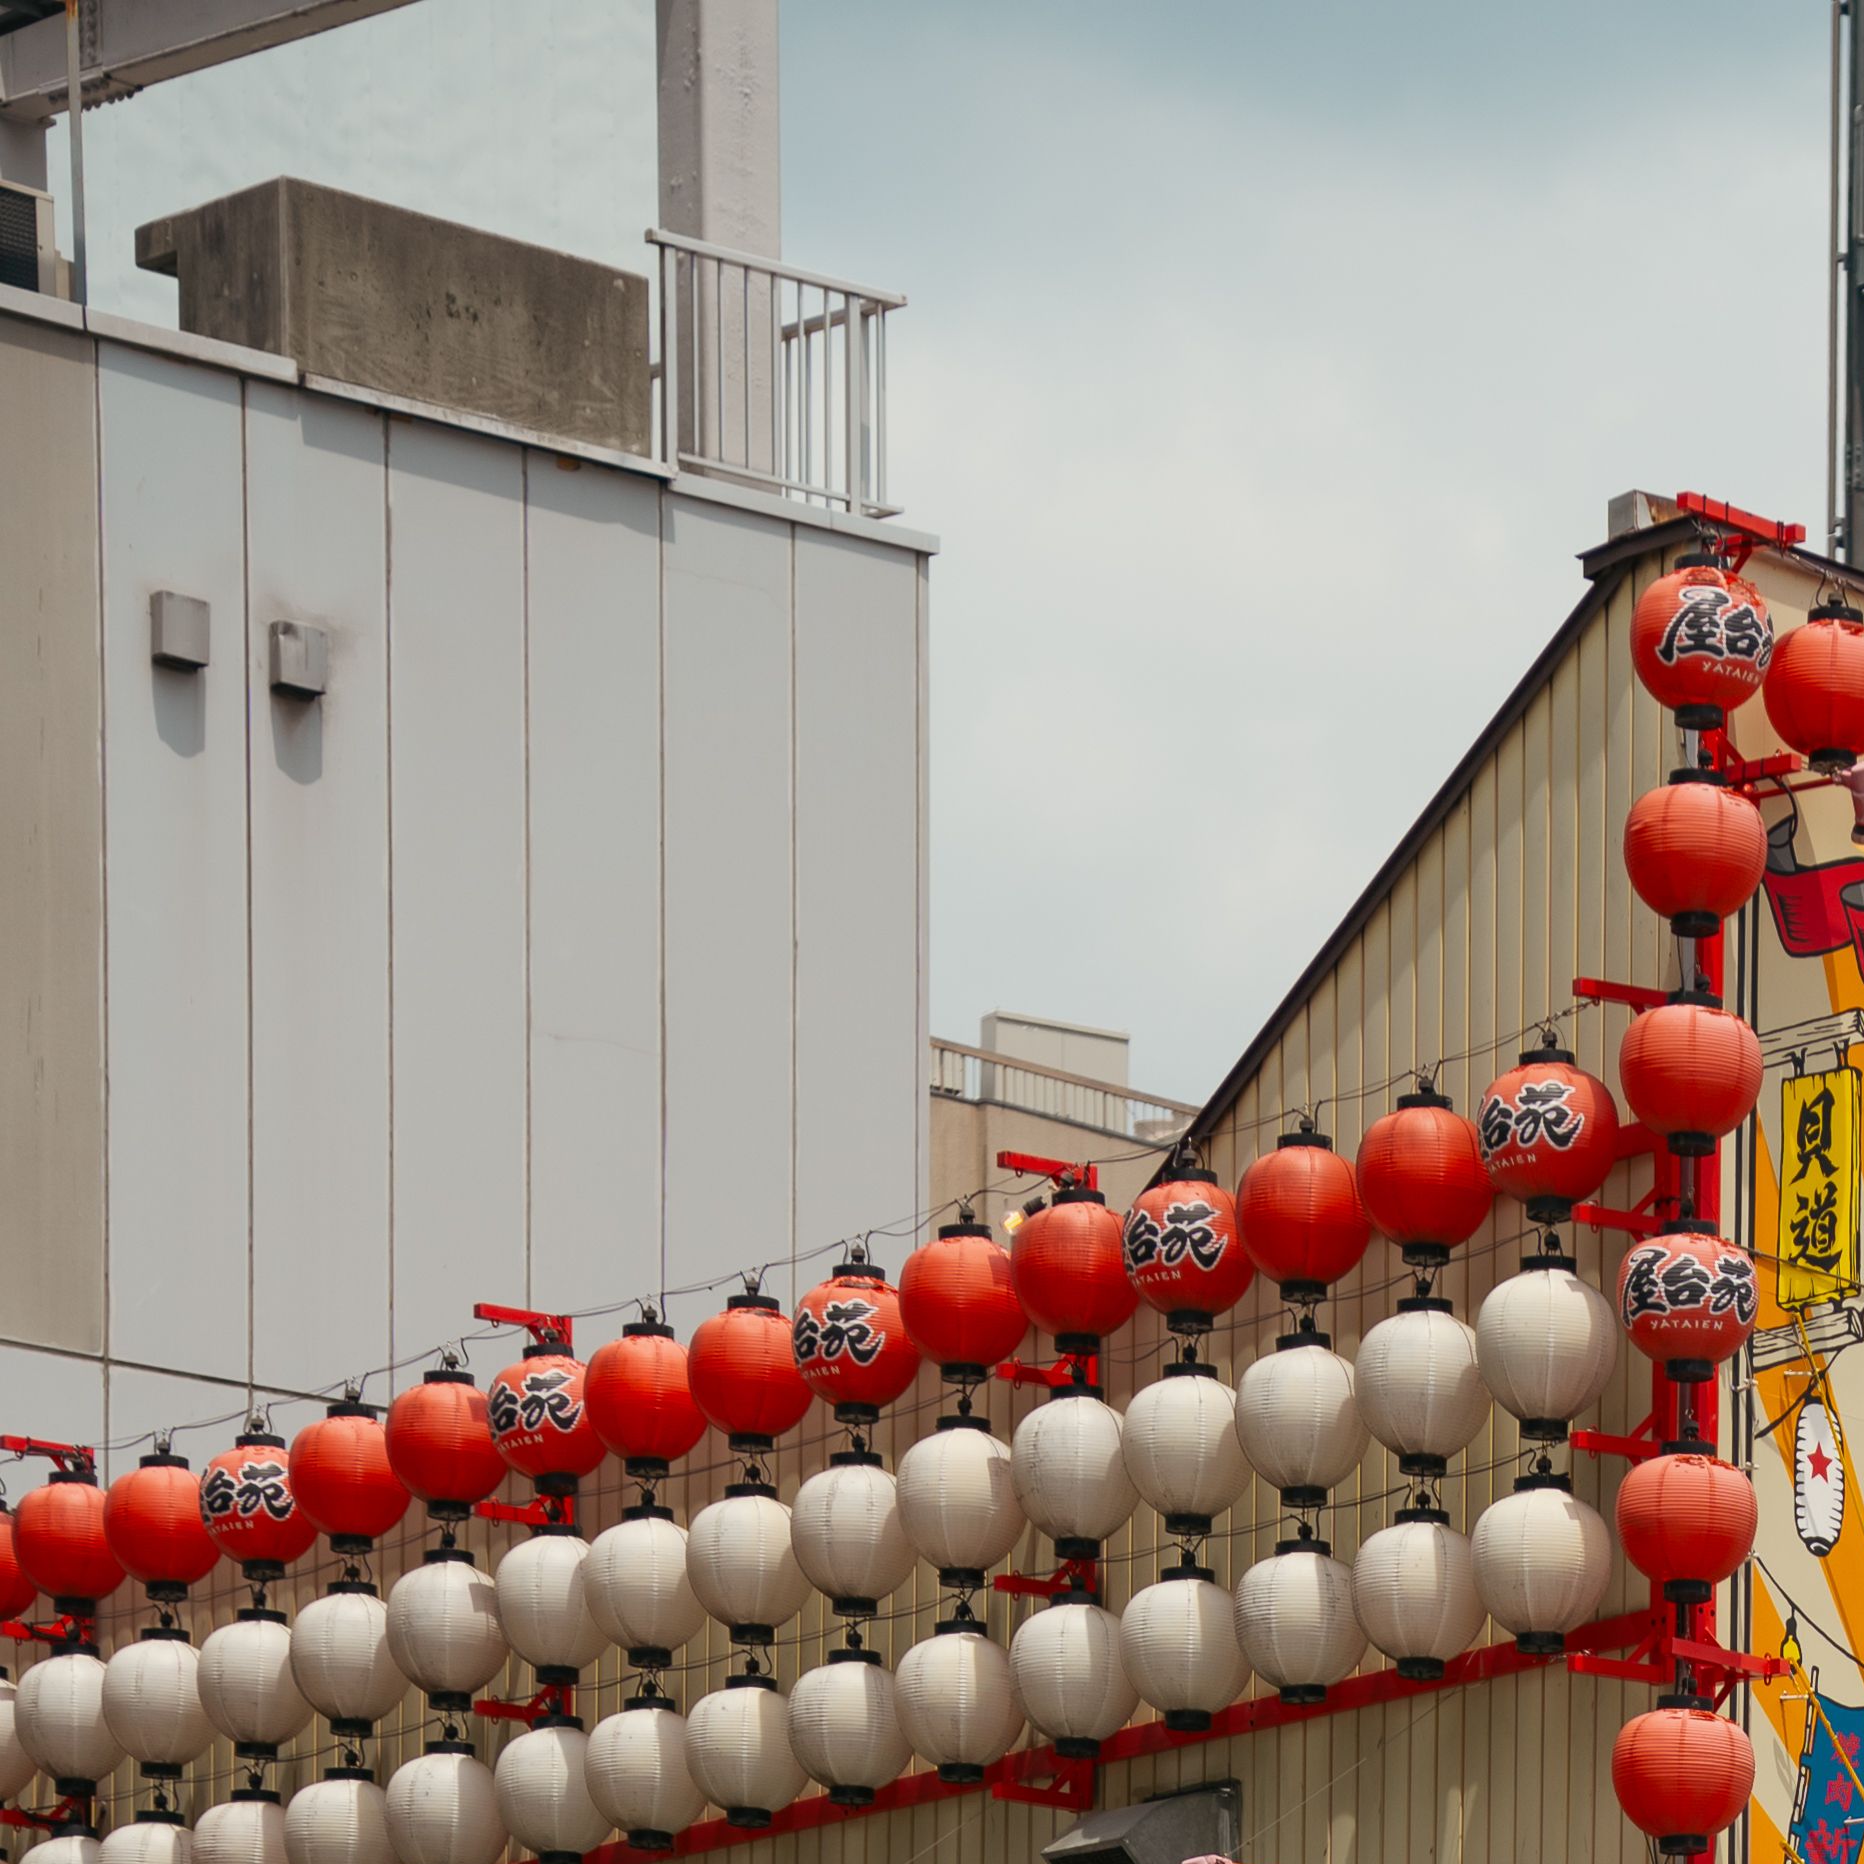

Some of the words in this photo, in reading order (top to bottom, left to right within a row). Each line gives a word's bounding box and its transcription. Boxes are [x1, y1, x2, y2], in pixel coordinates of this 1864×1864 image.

[1655, 586, 1774, 668] 屋台
[1478, 1080, 1586, 1158] 台苑
[1123, 1200, 1228, 1274] 台苑
[1622, 1245, 1758, 1328] 屋台苑
[792, 1297, 886, 1366] 台苑
[1650, 1319, 1723, 1331] YATAIEN
[487, 1368, 584, 1434] 台苑
[201, 1461, 297, 1521] 台苑
